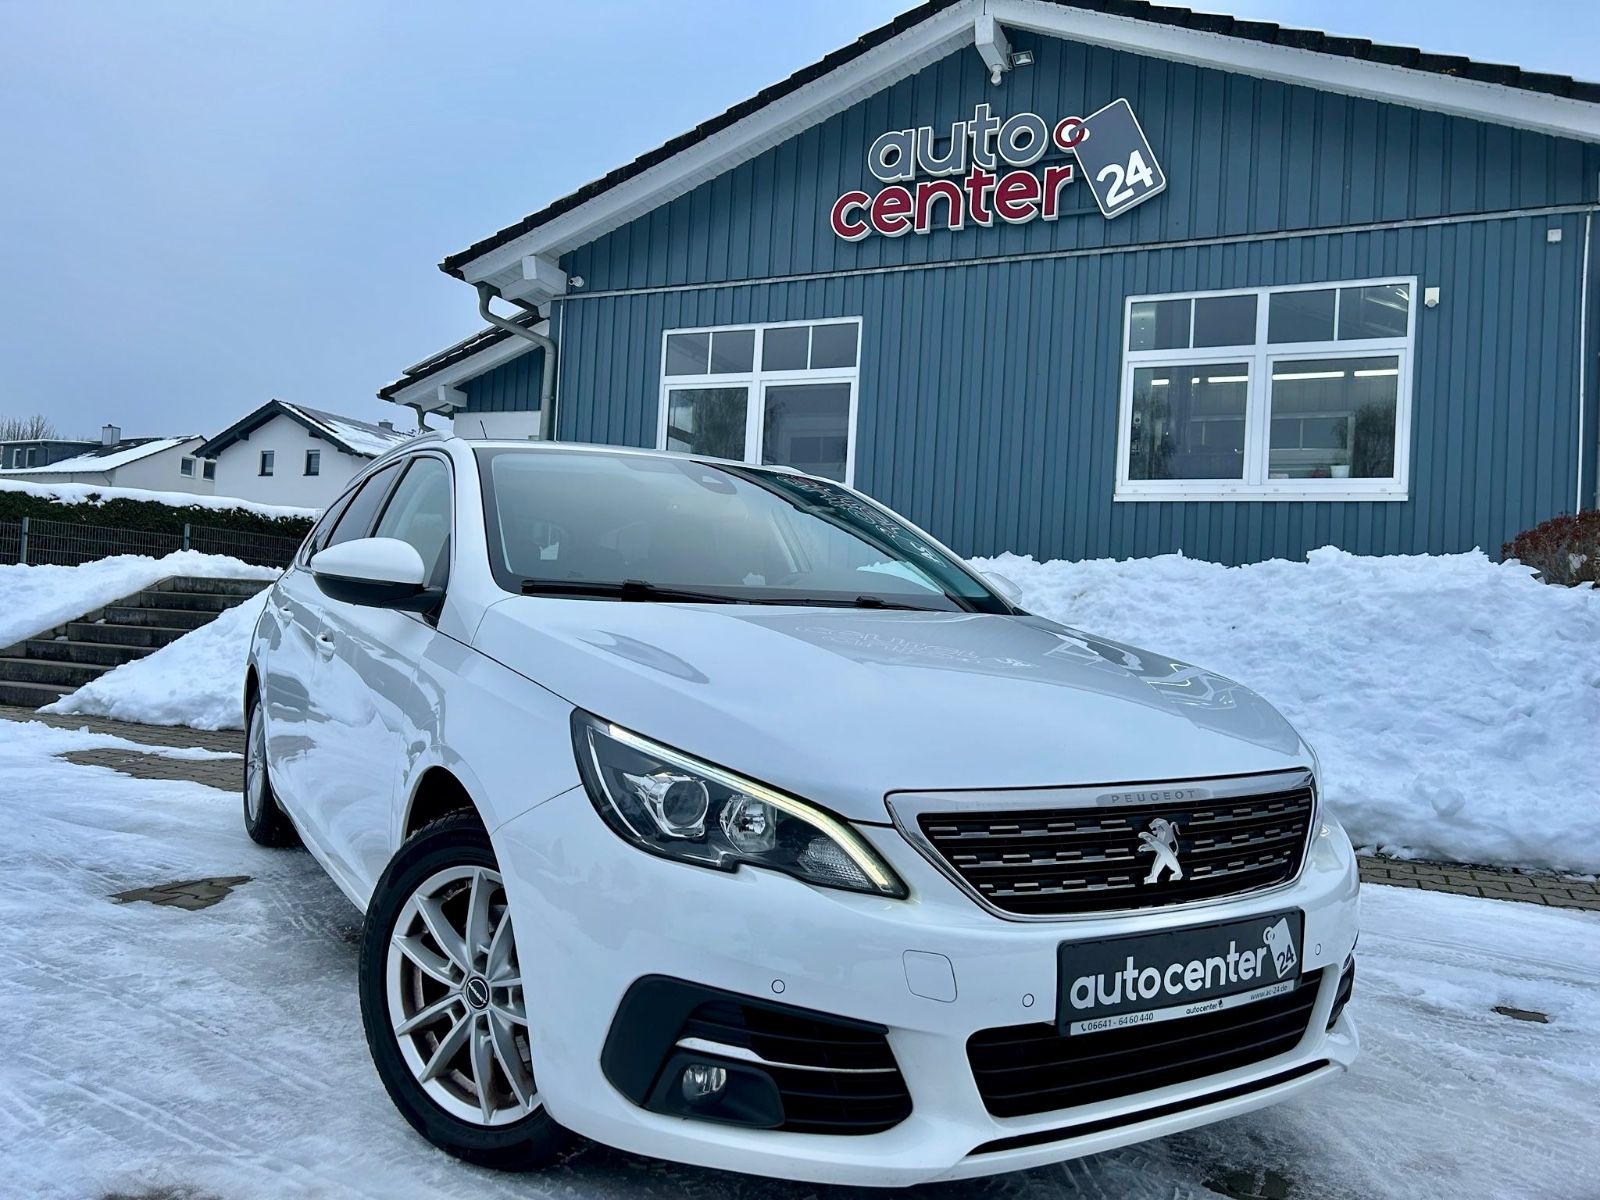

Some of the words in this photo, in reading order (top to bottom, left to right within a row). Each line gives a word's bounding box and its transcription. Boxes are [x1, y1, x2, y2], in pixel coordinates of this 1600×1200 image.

[868, 103, 1049, 182] auto
[830, 162, 1074, 242] center
[1096, 149, 1153, 208] 24
[1111, 790, 1195, 803] PEUGEOT
[1069, 940, 1267, 1010] autocenter
[1276, 943, 1295, 975] 24
[1087, 1020, 1112, 1031] 06641
[1185, 1003, 1218, 1015] autocenter
